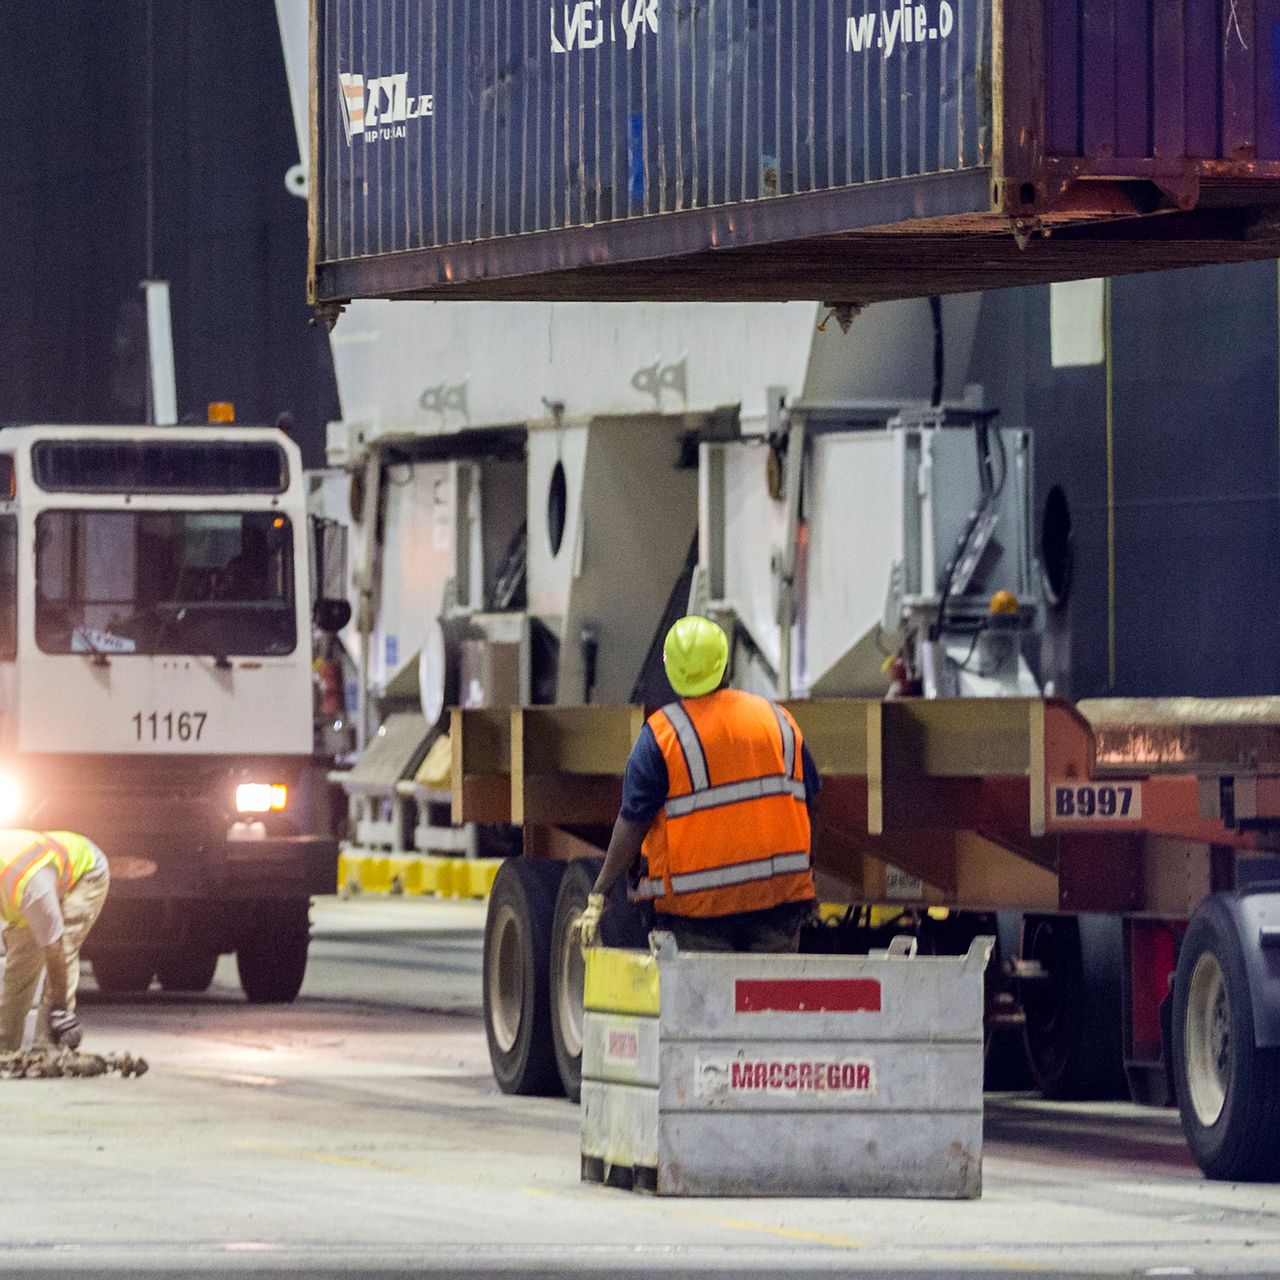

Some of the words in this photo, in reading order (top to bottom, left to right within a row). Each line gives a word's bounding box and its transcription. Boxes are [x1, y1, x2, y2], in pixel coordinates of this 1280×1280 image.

[133, 710, 208, 742] 11167
[1056, 787, 1132, 816] B997
[731, 1061, 871, 1090] MACGREGOR
